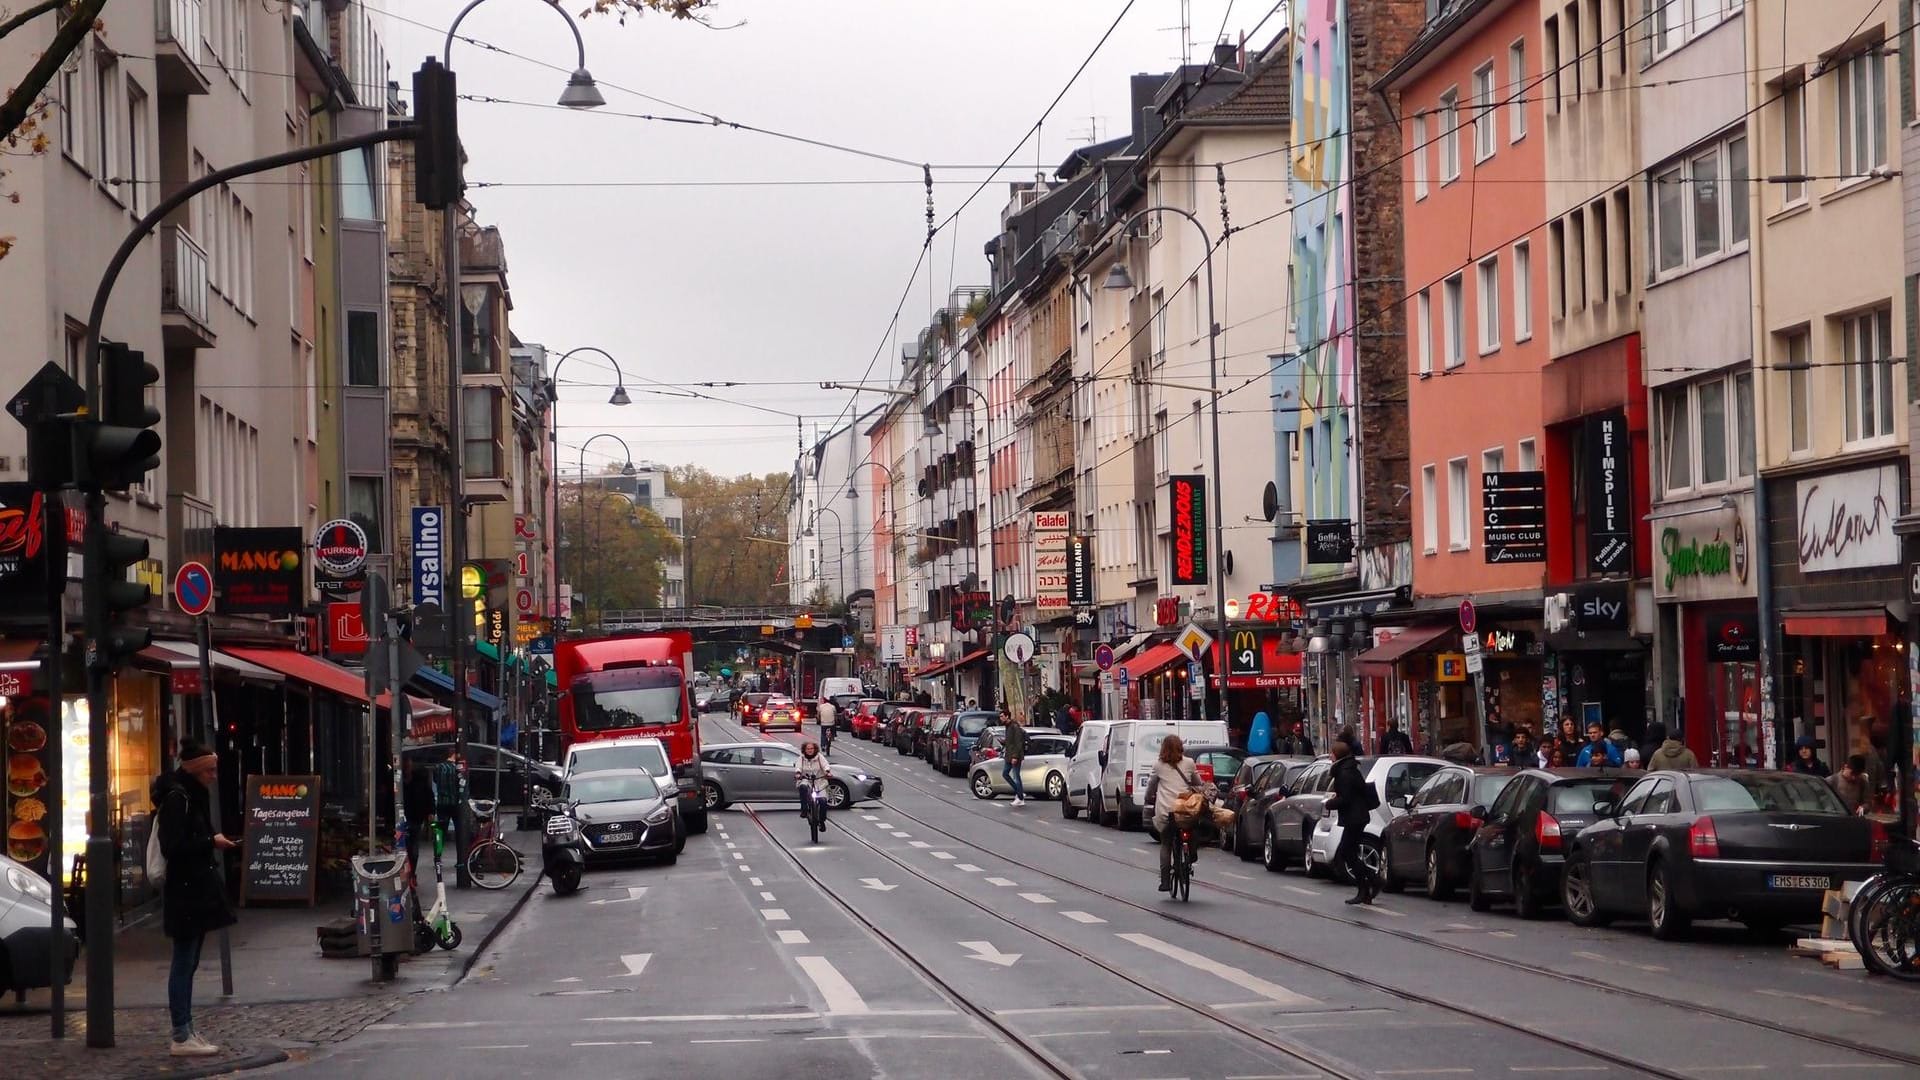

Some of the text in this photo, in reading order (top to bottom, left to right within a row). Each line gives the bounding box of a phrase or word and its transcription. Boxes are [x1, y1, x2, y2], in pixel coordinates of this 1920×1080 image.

[1602, 420, 1615, 531] HEIMSPIEL
[1036, 514, 1068, 528] Falafel
[1176, 480, 1193, 580] RENDEZVOUS
[1488, 531, 1541, 540] MUSIC CLUB
[321, 546, 360, 558] TURKISH
[1601, 541, 1628, 568] Karaoke
[1074, 542, 1084, 598] HILLEBRAND
[1039, 595, 1068, 608] Schawarm
[1583, 596, 1622, 619] sky
[1256, 677, 1277, 686] Essen
[1279, 677, 1285, 686] &
[1287, 677, 1303, 686] Trin
[252, 808, 310, 822] Tagesangebot
[259, 834, 304, 844] alle Pizzen
[1773, 876, 1792, 888] EMS
